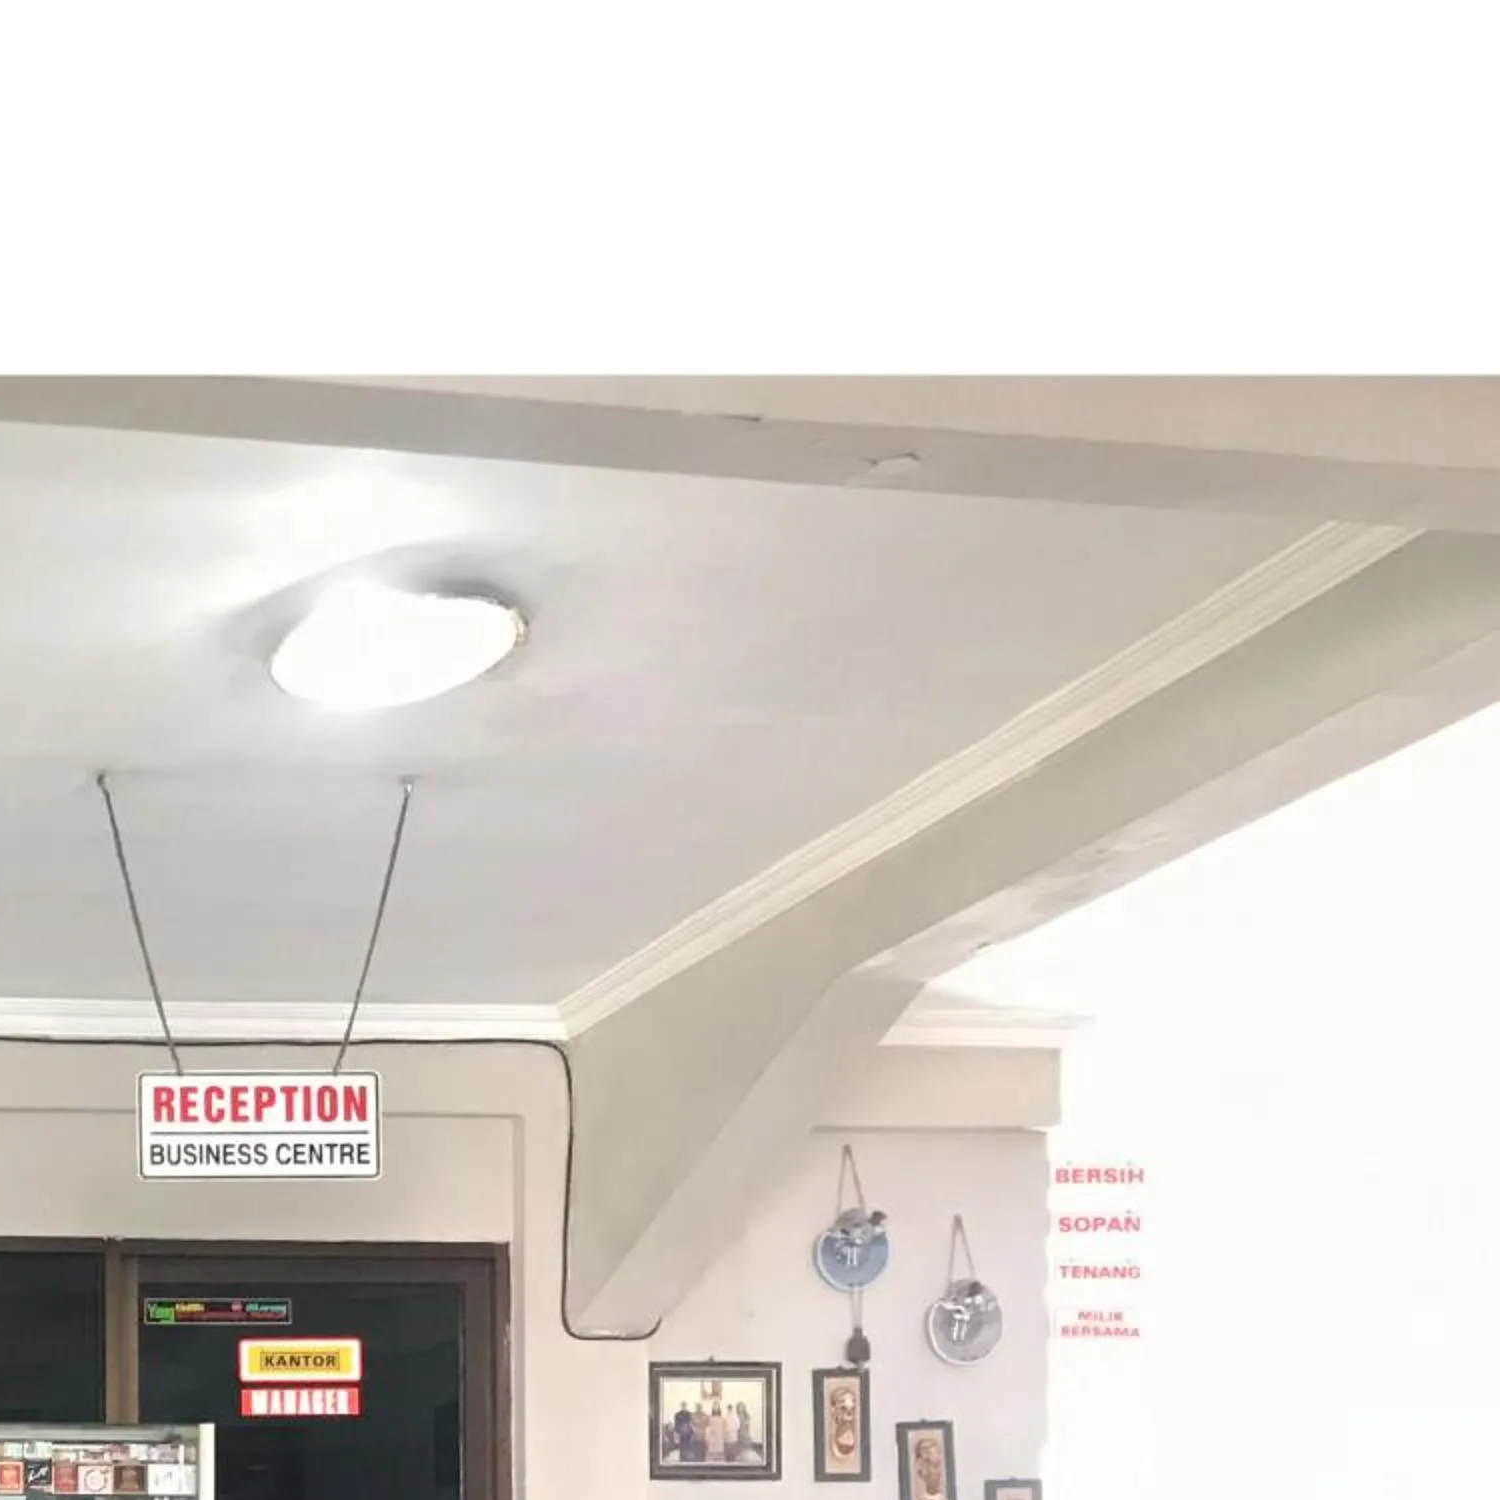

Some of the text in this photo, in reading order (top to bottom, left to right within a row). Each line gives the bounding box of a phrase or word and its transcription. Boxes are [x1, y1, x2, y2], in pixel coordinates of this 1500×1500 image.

[153, 1086, 368, 1122] RECEPTION
[150, 1143, 370, 1165] BUSINESS CENTRE
[1055, 1168, 1144, 1183] BERSIH
[1058, 1217, 1141, 1232] SOPAN
[1059, 1266, 1141, 1279] TENANG
[1077, 1311, 1124, 1321] MILIK
[1060, 1326, 1140, 1337] BERSAMA
[264, 1355, 337, 1367] KANTOR
[250, 1389, 349, 1415] MANAGER
